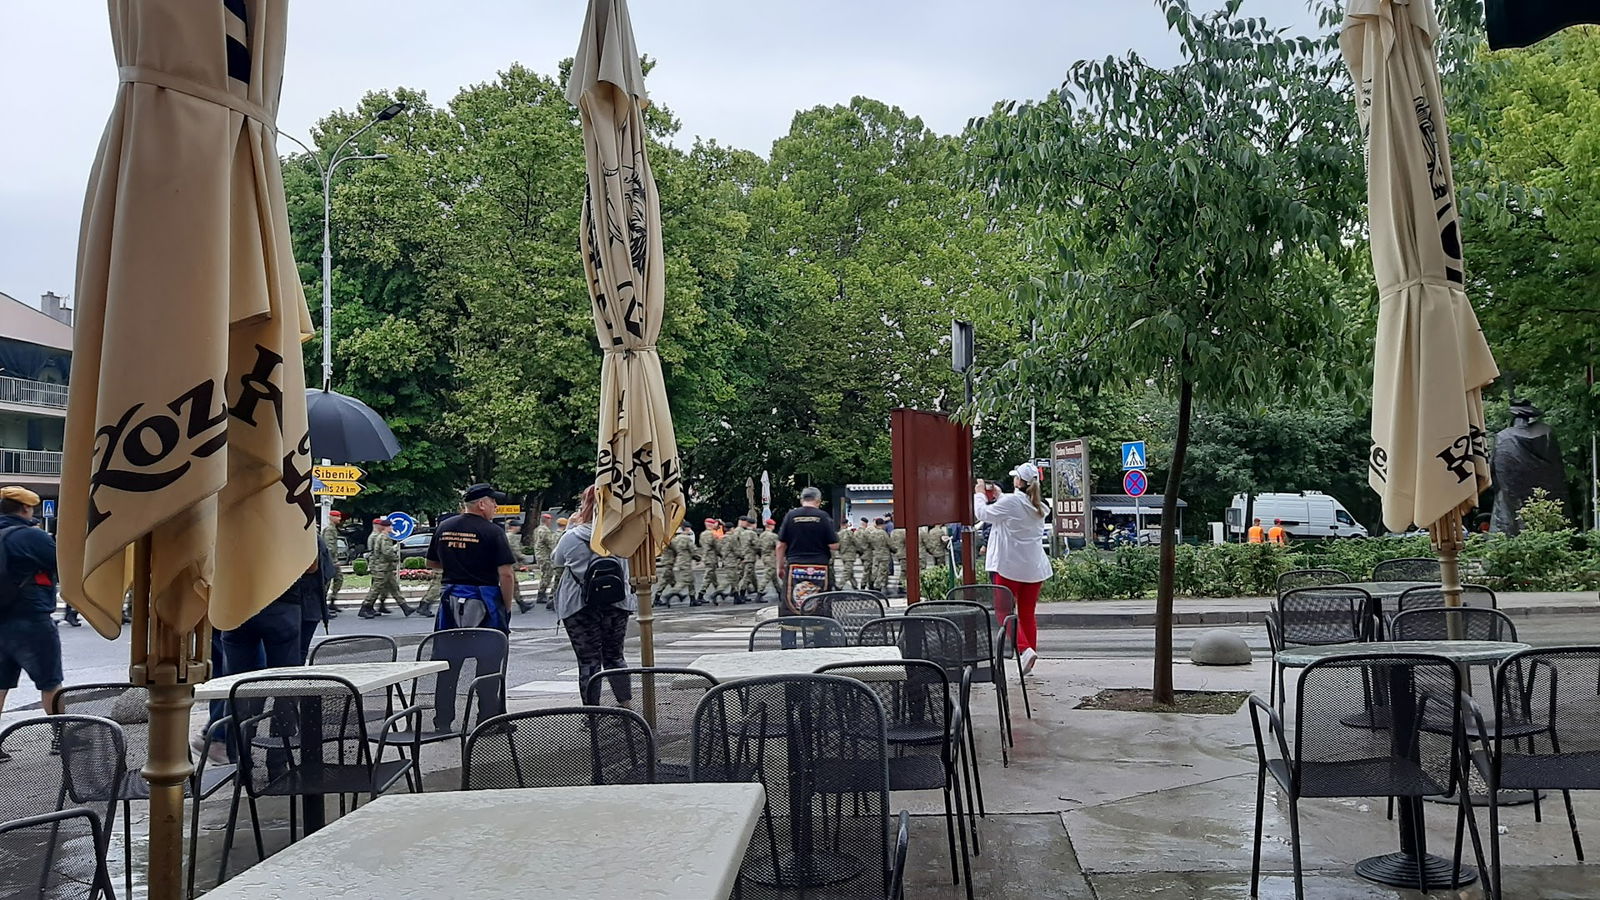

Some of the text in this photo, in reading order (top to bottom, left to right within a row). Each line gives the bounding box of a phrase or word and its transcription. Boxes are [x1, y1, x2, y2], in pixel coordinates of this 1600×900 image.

[314, 467, 354, 479] Šibenik
[336, 485, 345, 493] 24
[346, 485, 356, 493] km
